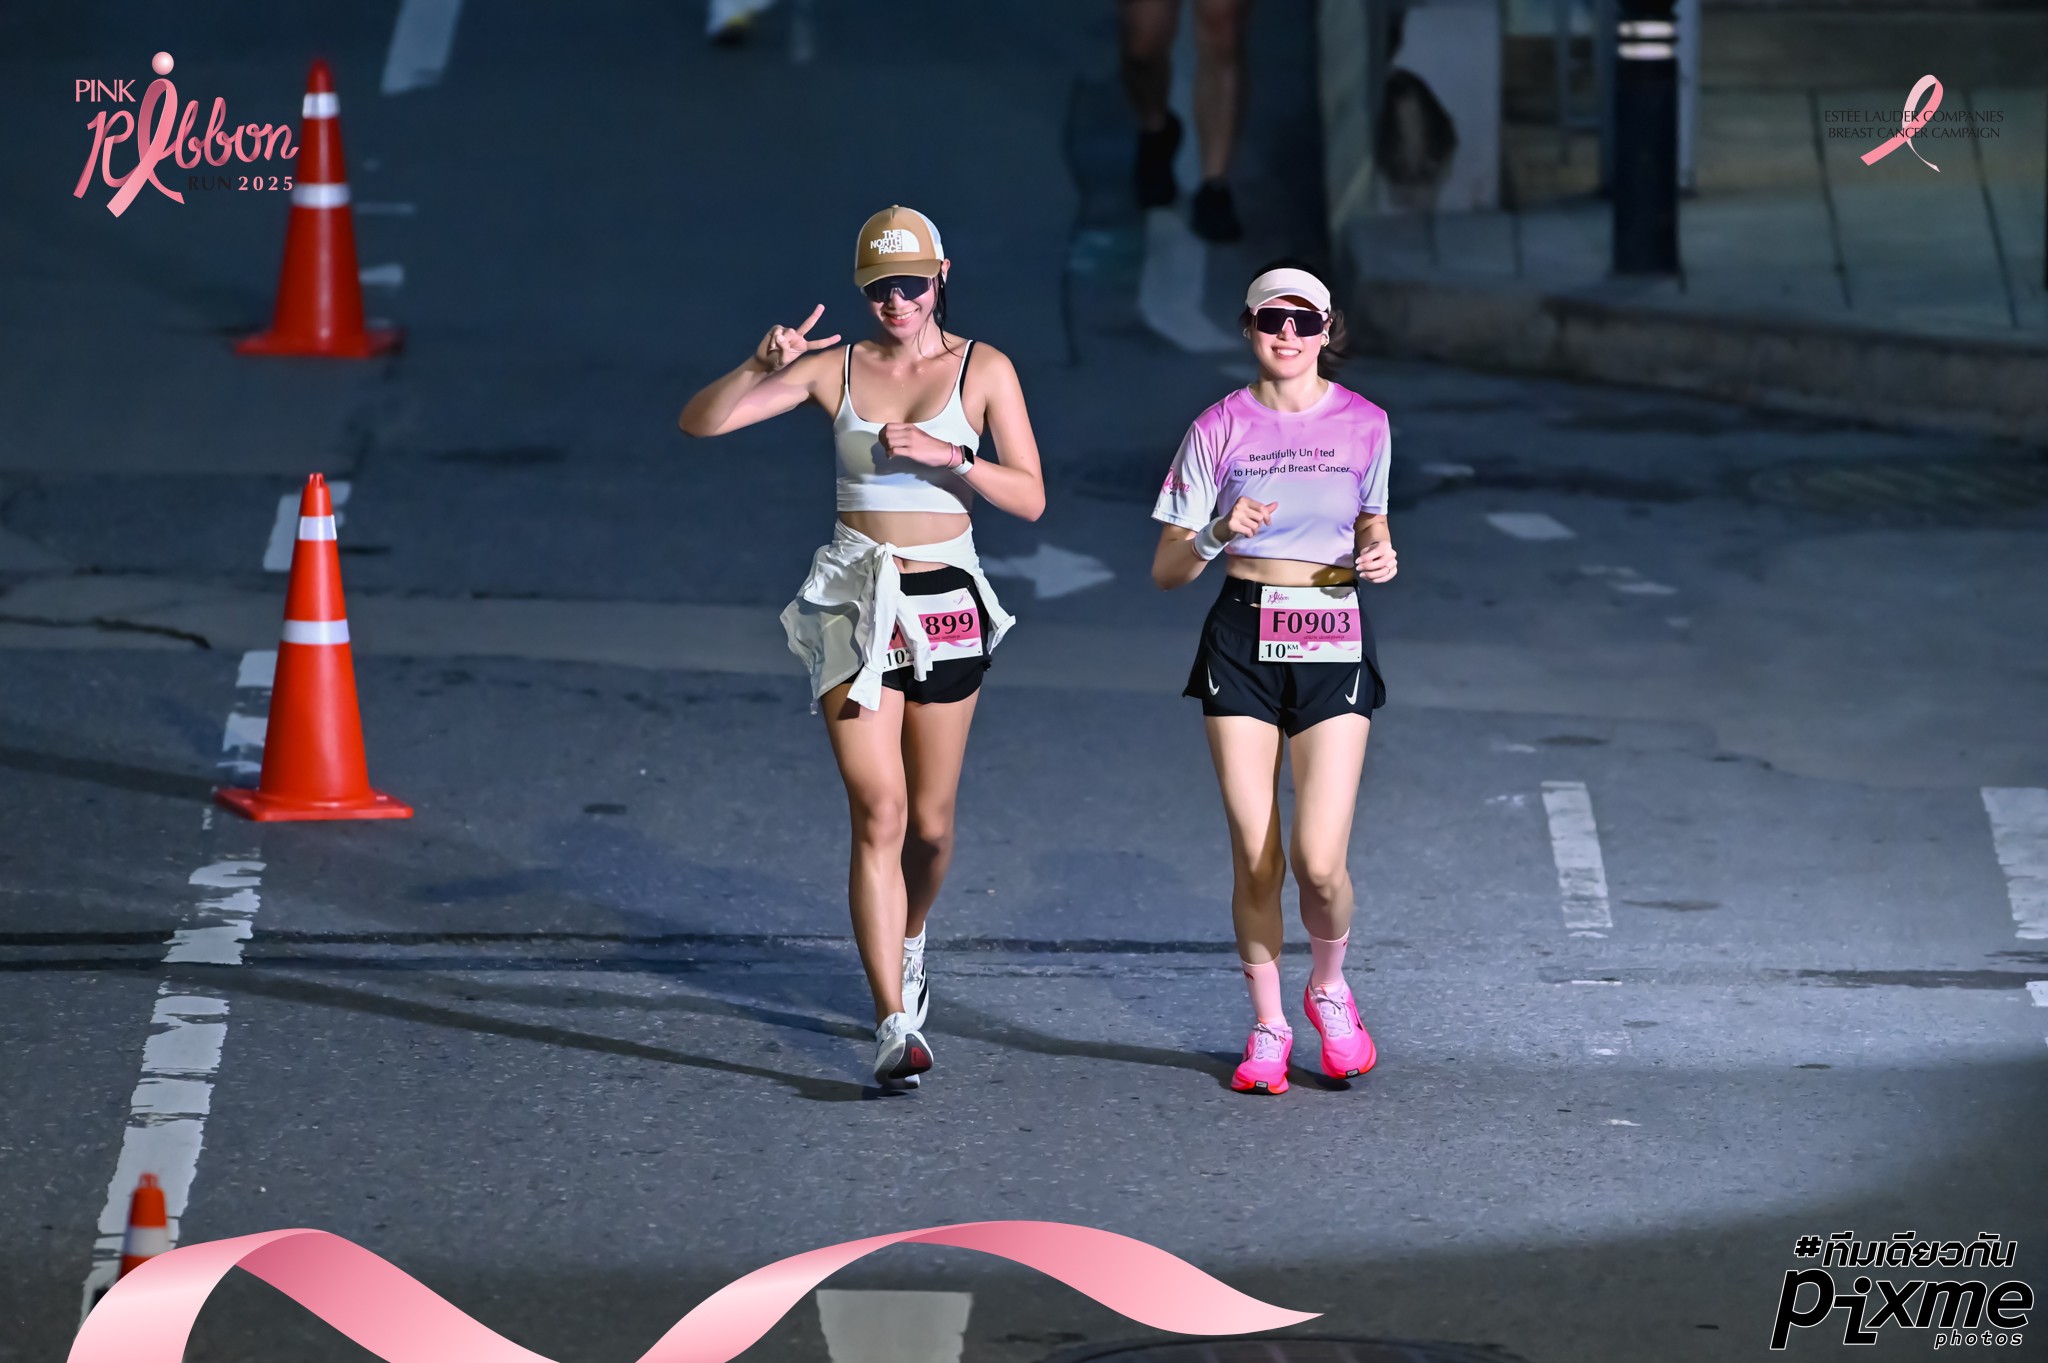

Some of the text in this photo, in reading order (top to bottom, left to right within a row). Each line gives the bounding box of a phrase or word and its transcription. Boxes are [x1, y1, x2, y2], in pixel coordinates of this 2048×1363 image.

[882, 229, 902, 240] THE
[870, 238, 902, 250] NORTH
[879, 246, 902, 254] FACE
[1249, 449, 1297, 462] Beautifully
[1234, 463, 1350, 478] to Help End Breast Cancer
[1272, 611, 1351, 634] F0903
[1265, 643, 1286, 658] 10
[886, 649, 906, 667] 10
